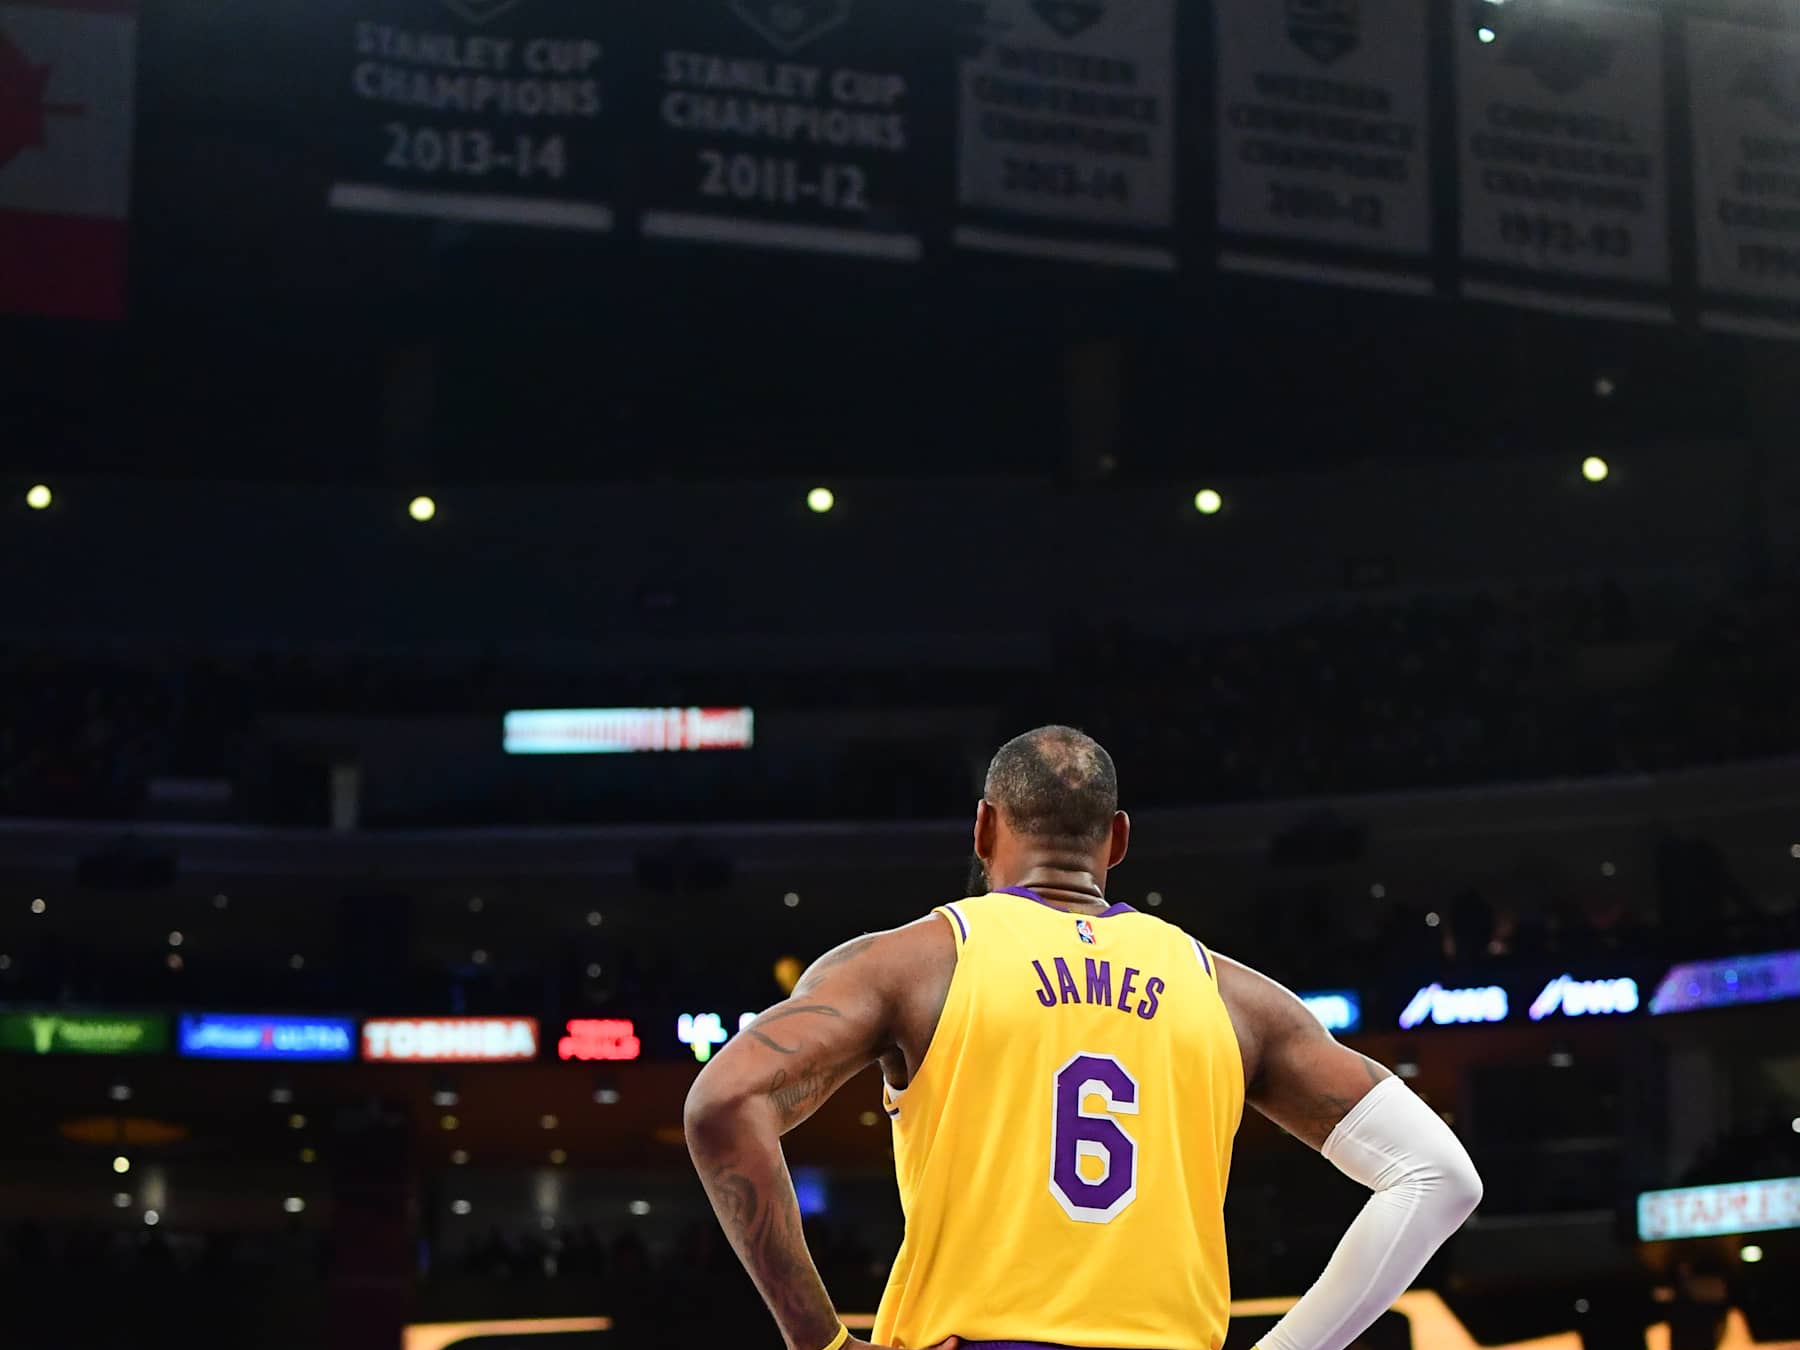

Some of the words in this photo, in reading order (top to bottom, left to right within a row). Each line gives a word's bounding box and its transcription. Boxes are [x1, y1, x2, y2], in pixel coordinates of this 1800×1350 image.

[354, 21, 512, 72] STANLEY
[523, 38, 601, 74] CUP
[352, 61, 600, 116] CHAMPIONS
[662, 50, 820, 101] STANLEY
[830, 68, 907, 105] CUP
[660, 92, 906, 150] CHAMPIONS
[384, 122, 568, 179] 2013-14
[699, 152, 869, 210] 2011-12
[1032, 957, 1165, 1020] JAMES
[363, 1020, 536, 1057] TOSHIBA
[1049, 1051, 1139, 1224] 6
